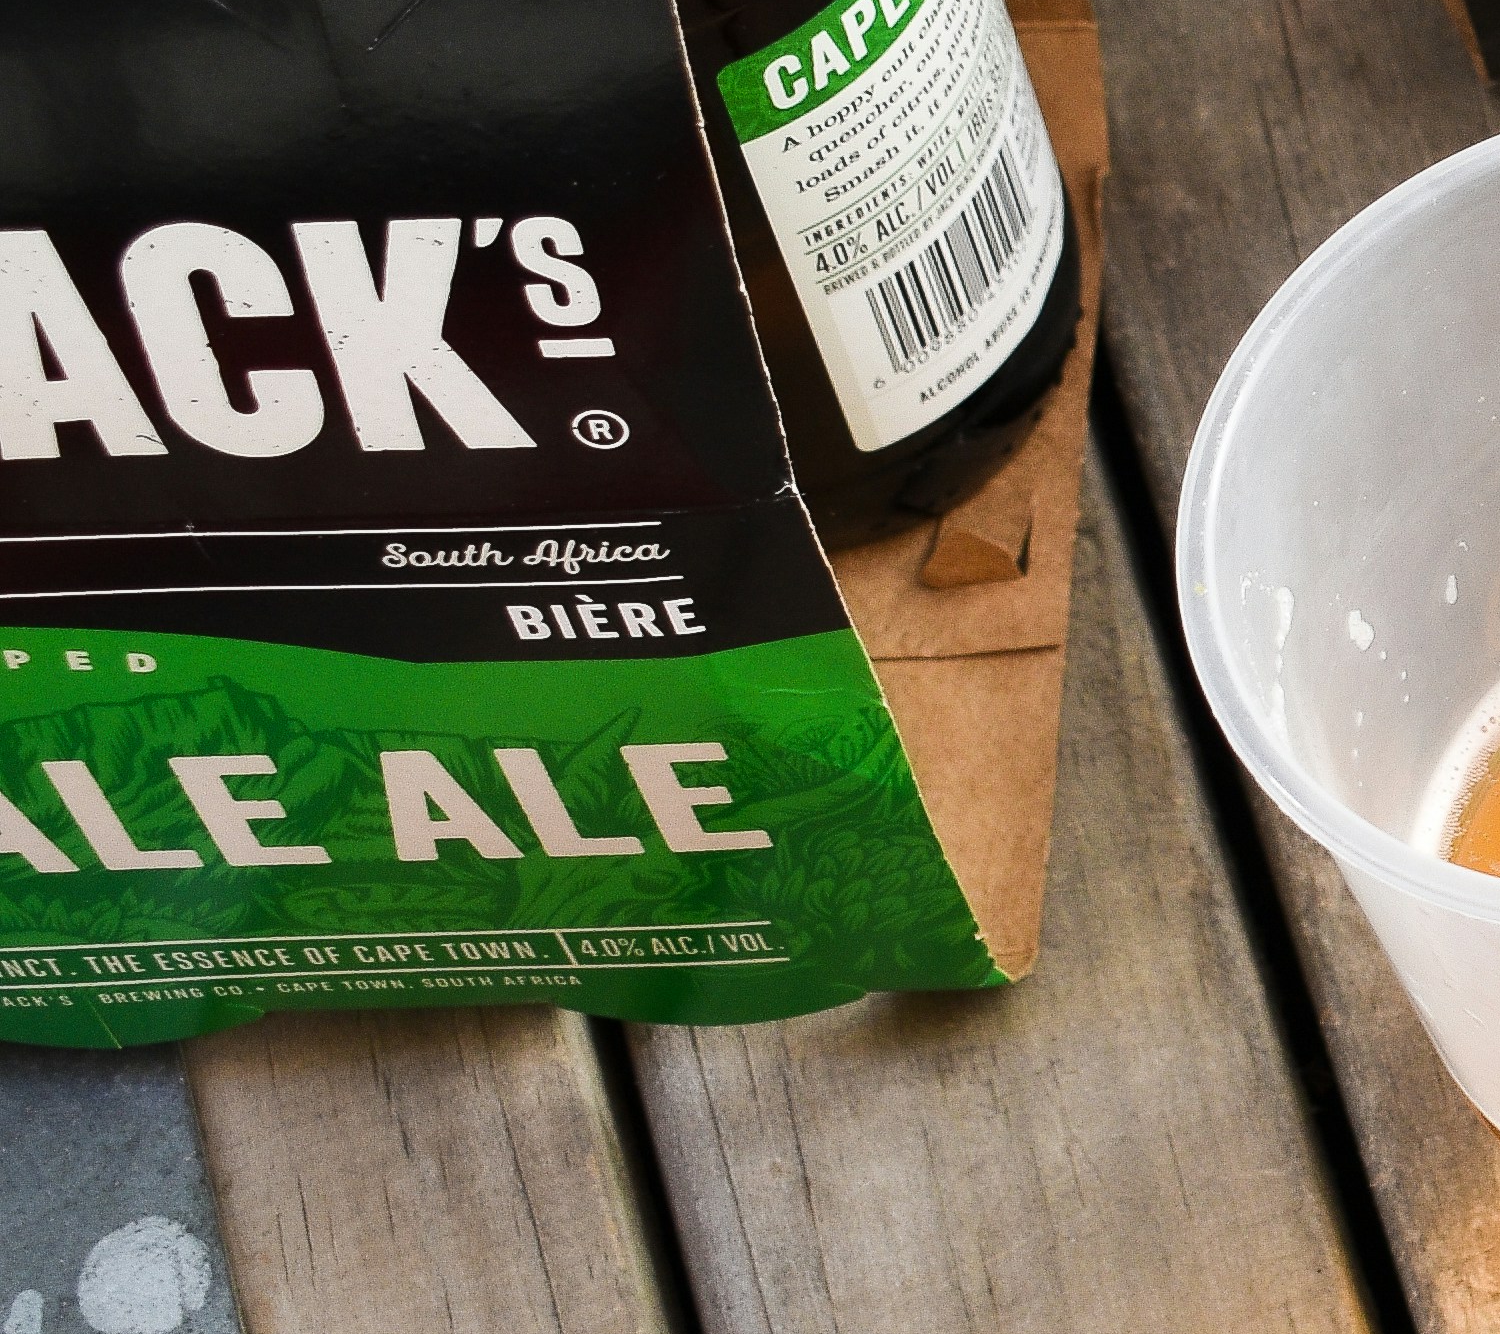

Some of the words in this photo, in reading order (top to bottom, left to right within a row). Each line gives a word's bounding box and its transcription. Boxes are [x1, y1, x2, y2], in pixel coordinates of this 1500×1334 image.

[781, 135, 802, 154] A
[805, 83, 876, 141] hoppy
[794, 148, 862, 195] loads
[866, 124, 887, 151] of
[823, 143, 901, 204] Smash
[814, 232, 869, 274] 4.0%
[380, 537, 515, 573] South
[522, 534, 672, 571] Africa
[505, 593, 708, 643] BIÈRE
[376, 739, 775, 863] ALE
[0, 957, 78, 978] NCT.
[83, 952, 146, 976] THE
[155, 946, 296, 972] ESSENCE
[302, 945, 341, 966] OF
[352, 942, 435, 965] CAPE
[580, 937, 646, 959] 4.0%
[99, 985, 205, 1006] BREWING
[278, 981, 334, 995] CAPE
[422, 975, 494, 989] SOUTH
[502, 973, 583, 987] AFRICA
